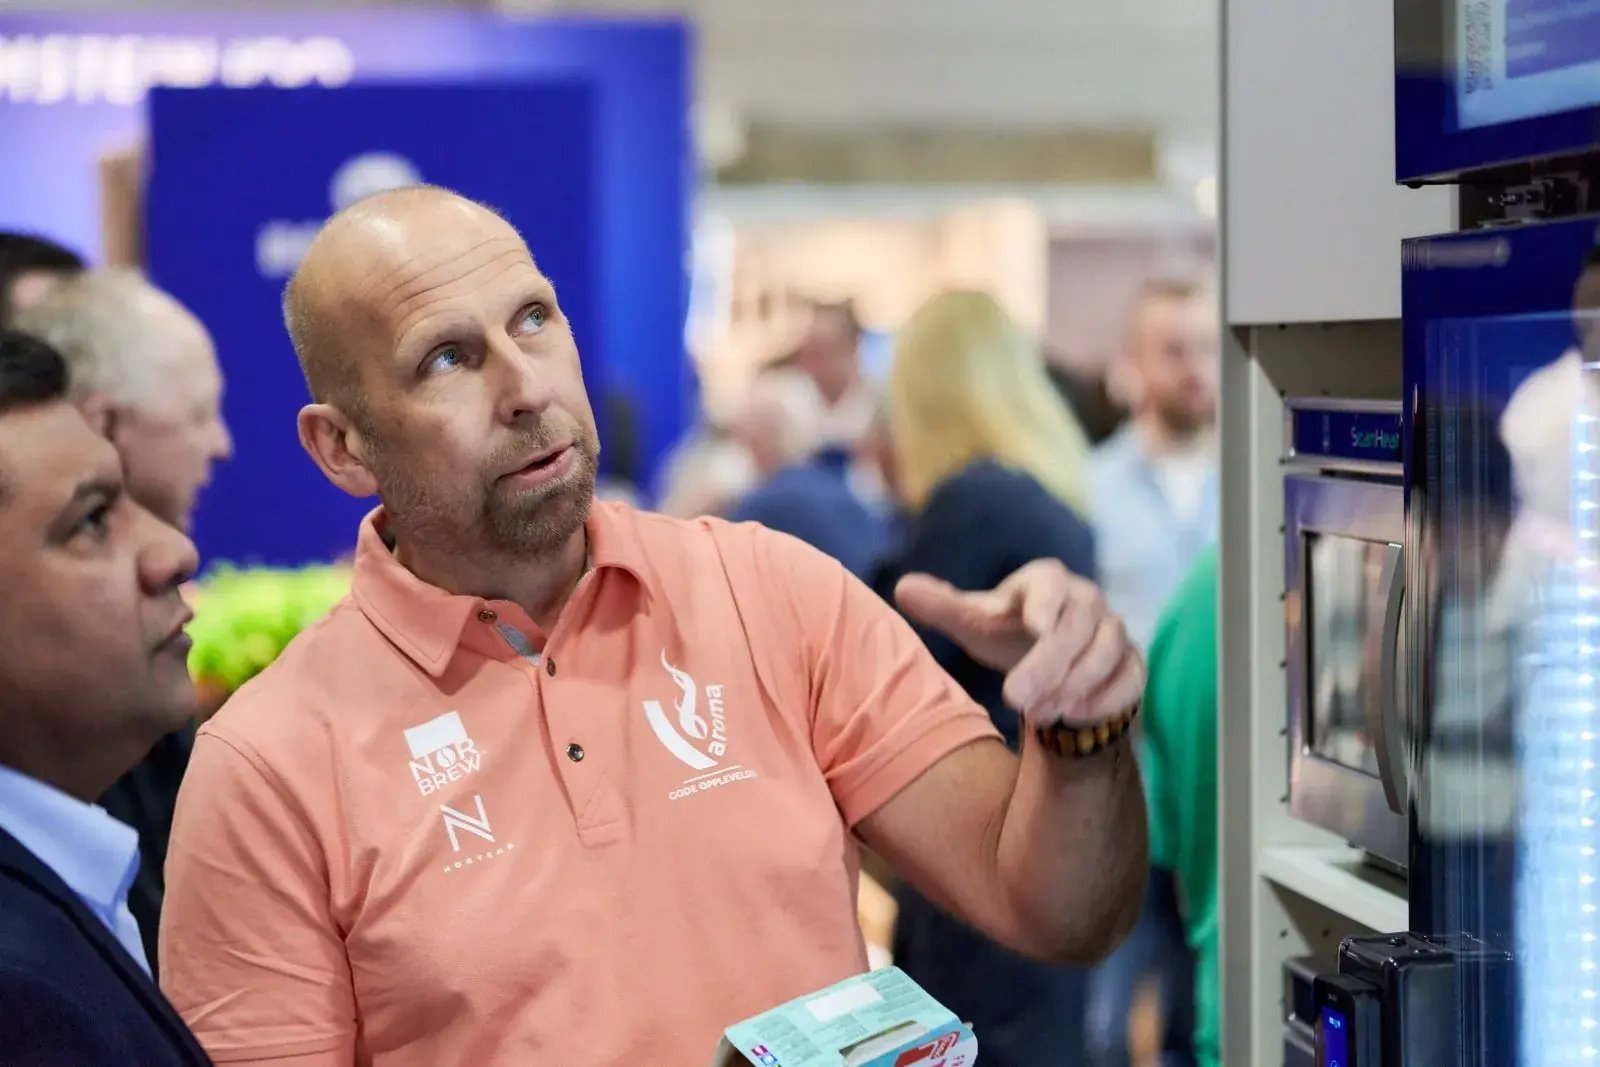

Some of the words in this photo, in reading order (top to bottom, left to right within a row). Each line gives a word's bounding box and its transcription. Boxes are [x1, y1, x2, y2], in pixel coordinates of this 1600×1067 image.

[705, 684, 728, 757] aroma
[408, 737, 478, 782] NOR
[417, 753, 481, 797] BREW
